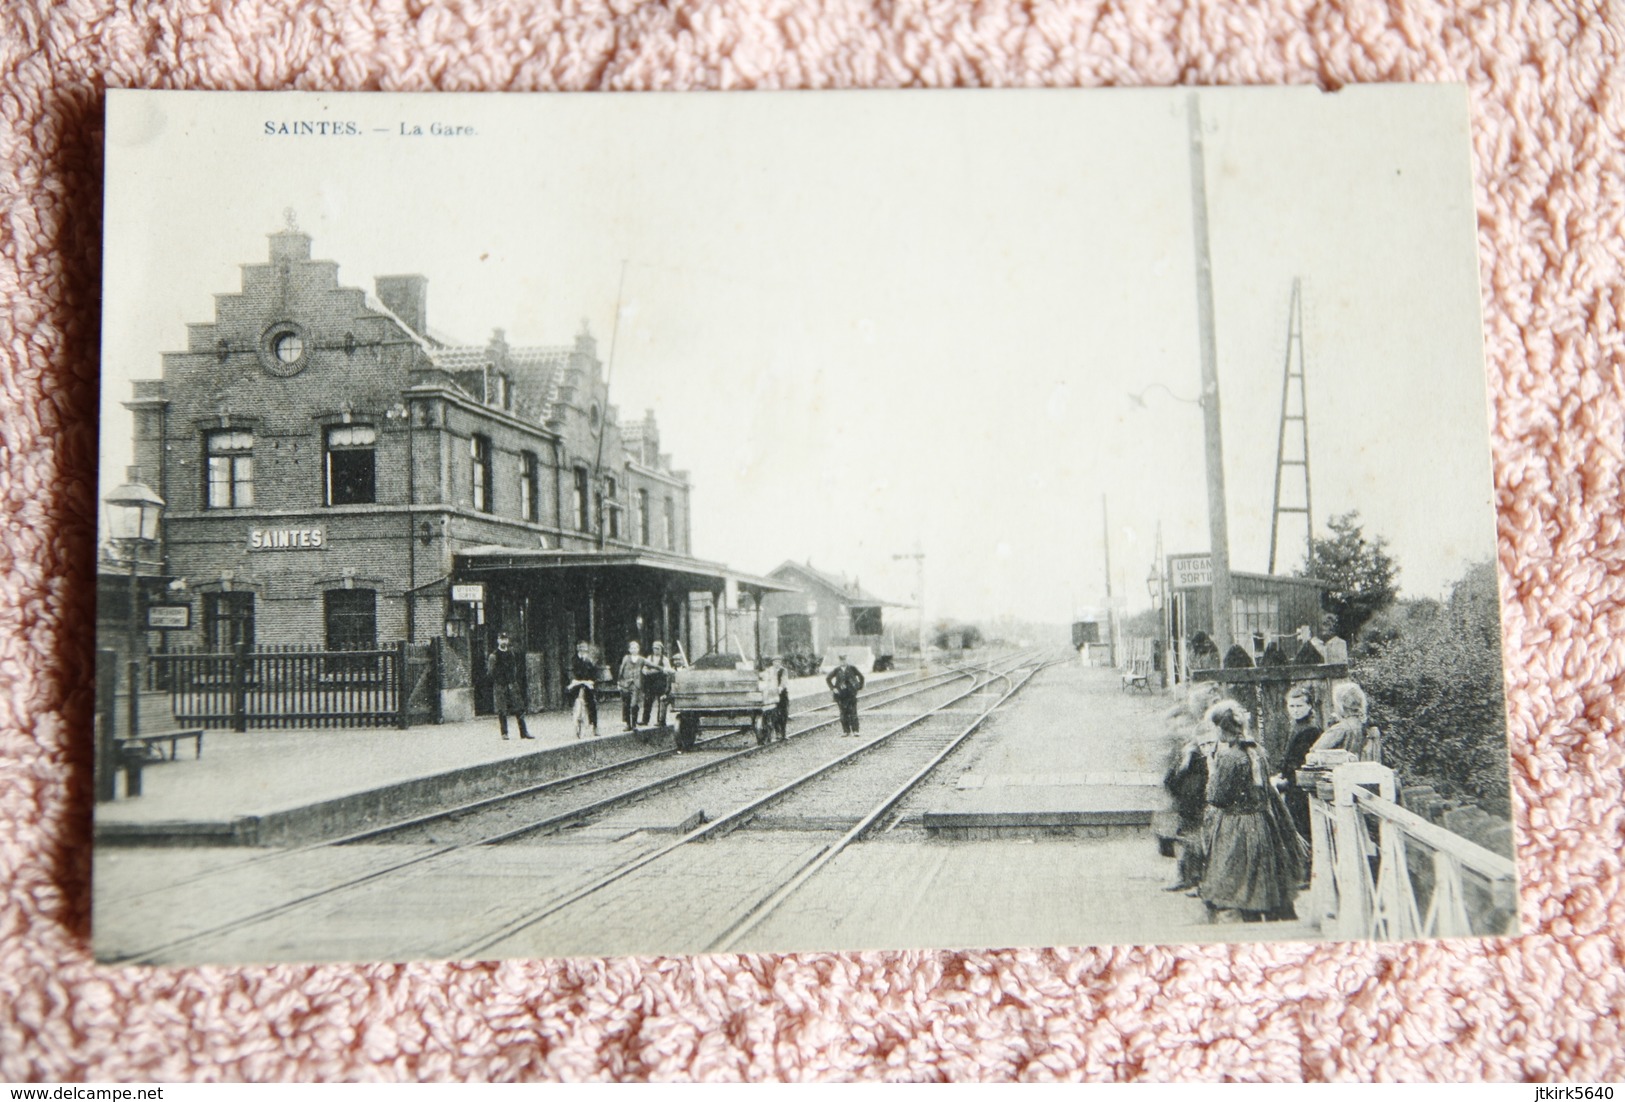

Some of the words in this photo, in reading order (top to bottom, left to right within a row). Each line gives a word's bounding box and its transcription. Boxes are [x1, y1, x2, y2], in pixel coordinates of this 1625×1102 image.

[264, 120, 362, 136] SAINTES.
[399, 121, 423, 136] La
[430, 121, 479, 136] Gare.
[251, 529, 322, 548] SAINTES
[1176, 559, 1212, 571] UITGAN
